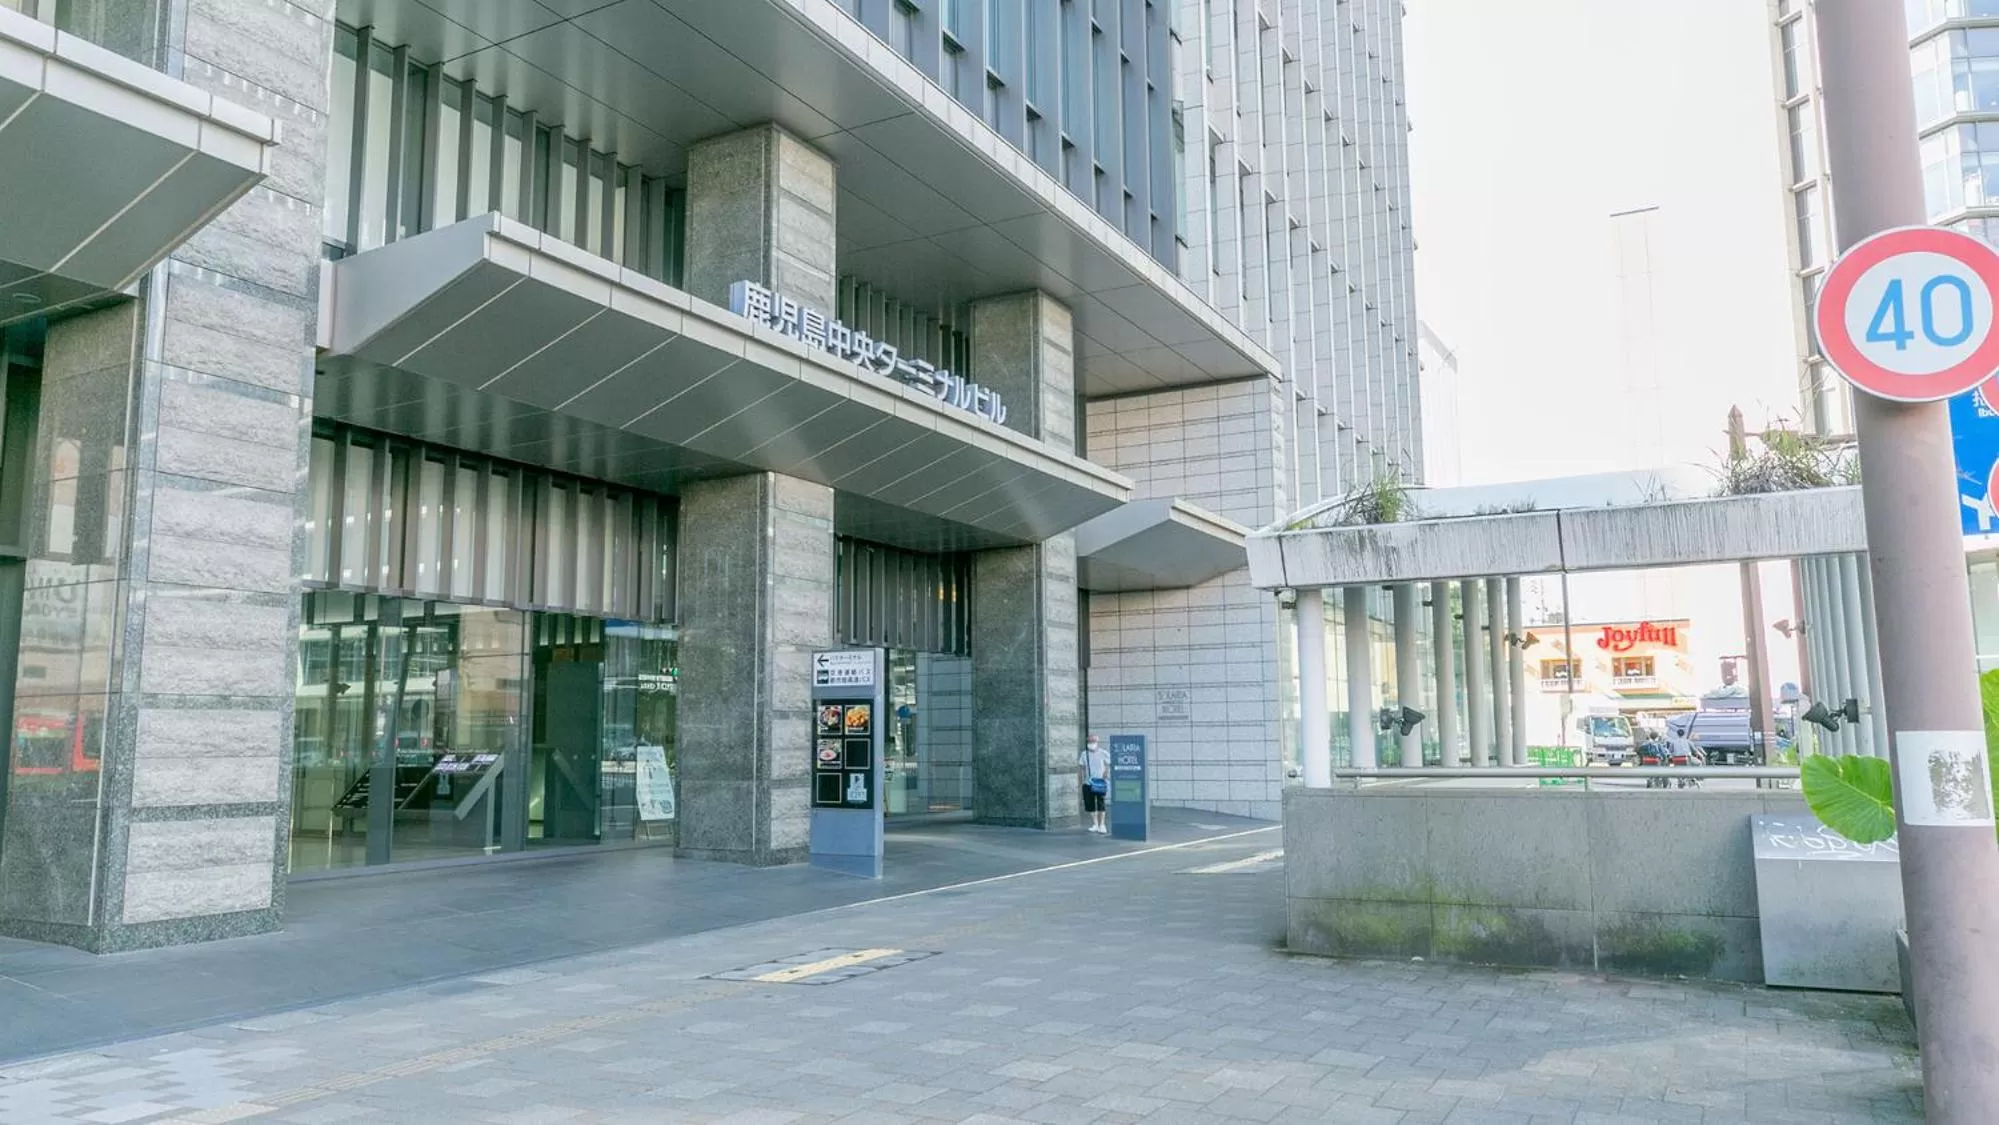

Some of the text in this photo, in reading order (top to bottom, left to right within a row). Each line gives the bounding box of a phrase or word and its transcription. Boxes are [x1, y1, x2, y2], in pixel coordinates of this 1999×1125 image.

[1865, 274, 1974, 351] 40
[737, 280, 1008, 425] 鹿児島中央ターミナルビル
[1597, 621, 1678, 652] Joyfull
